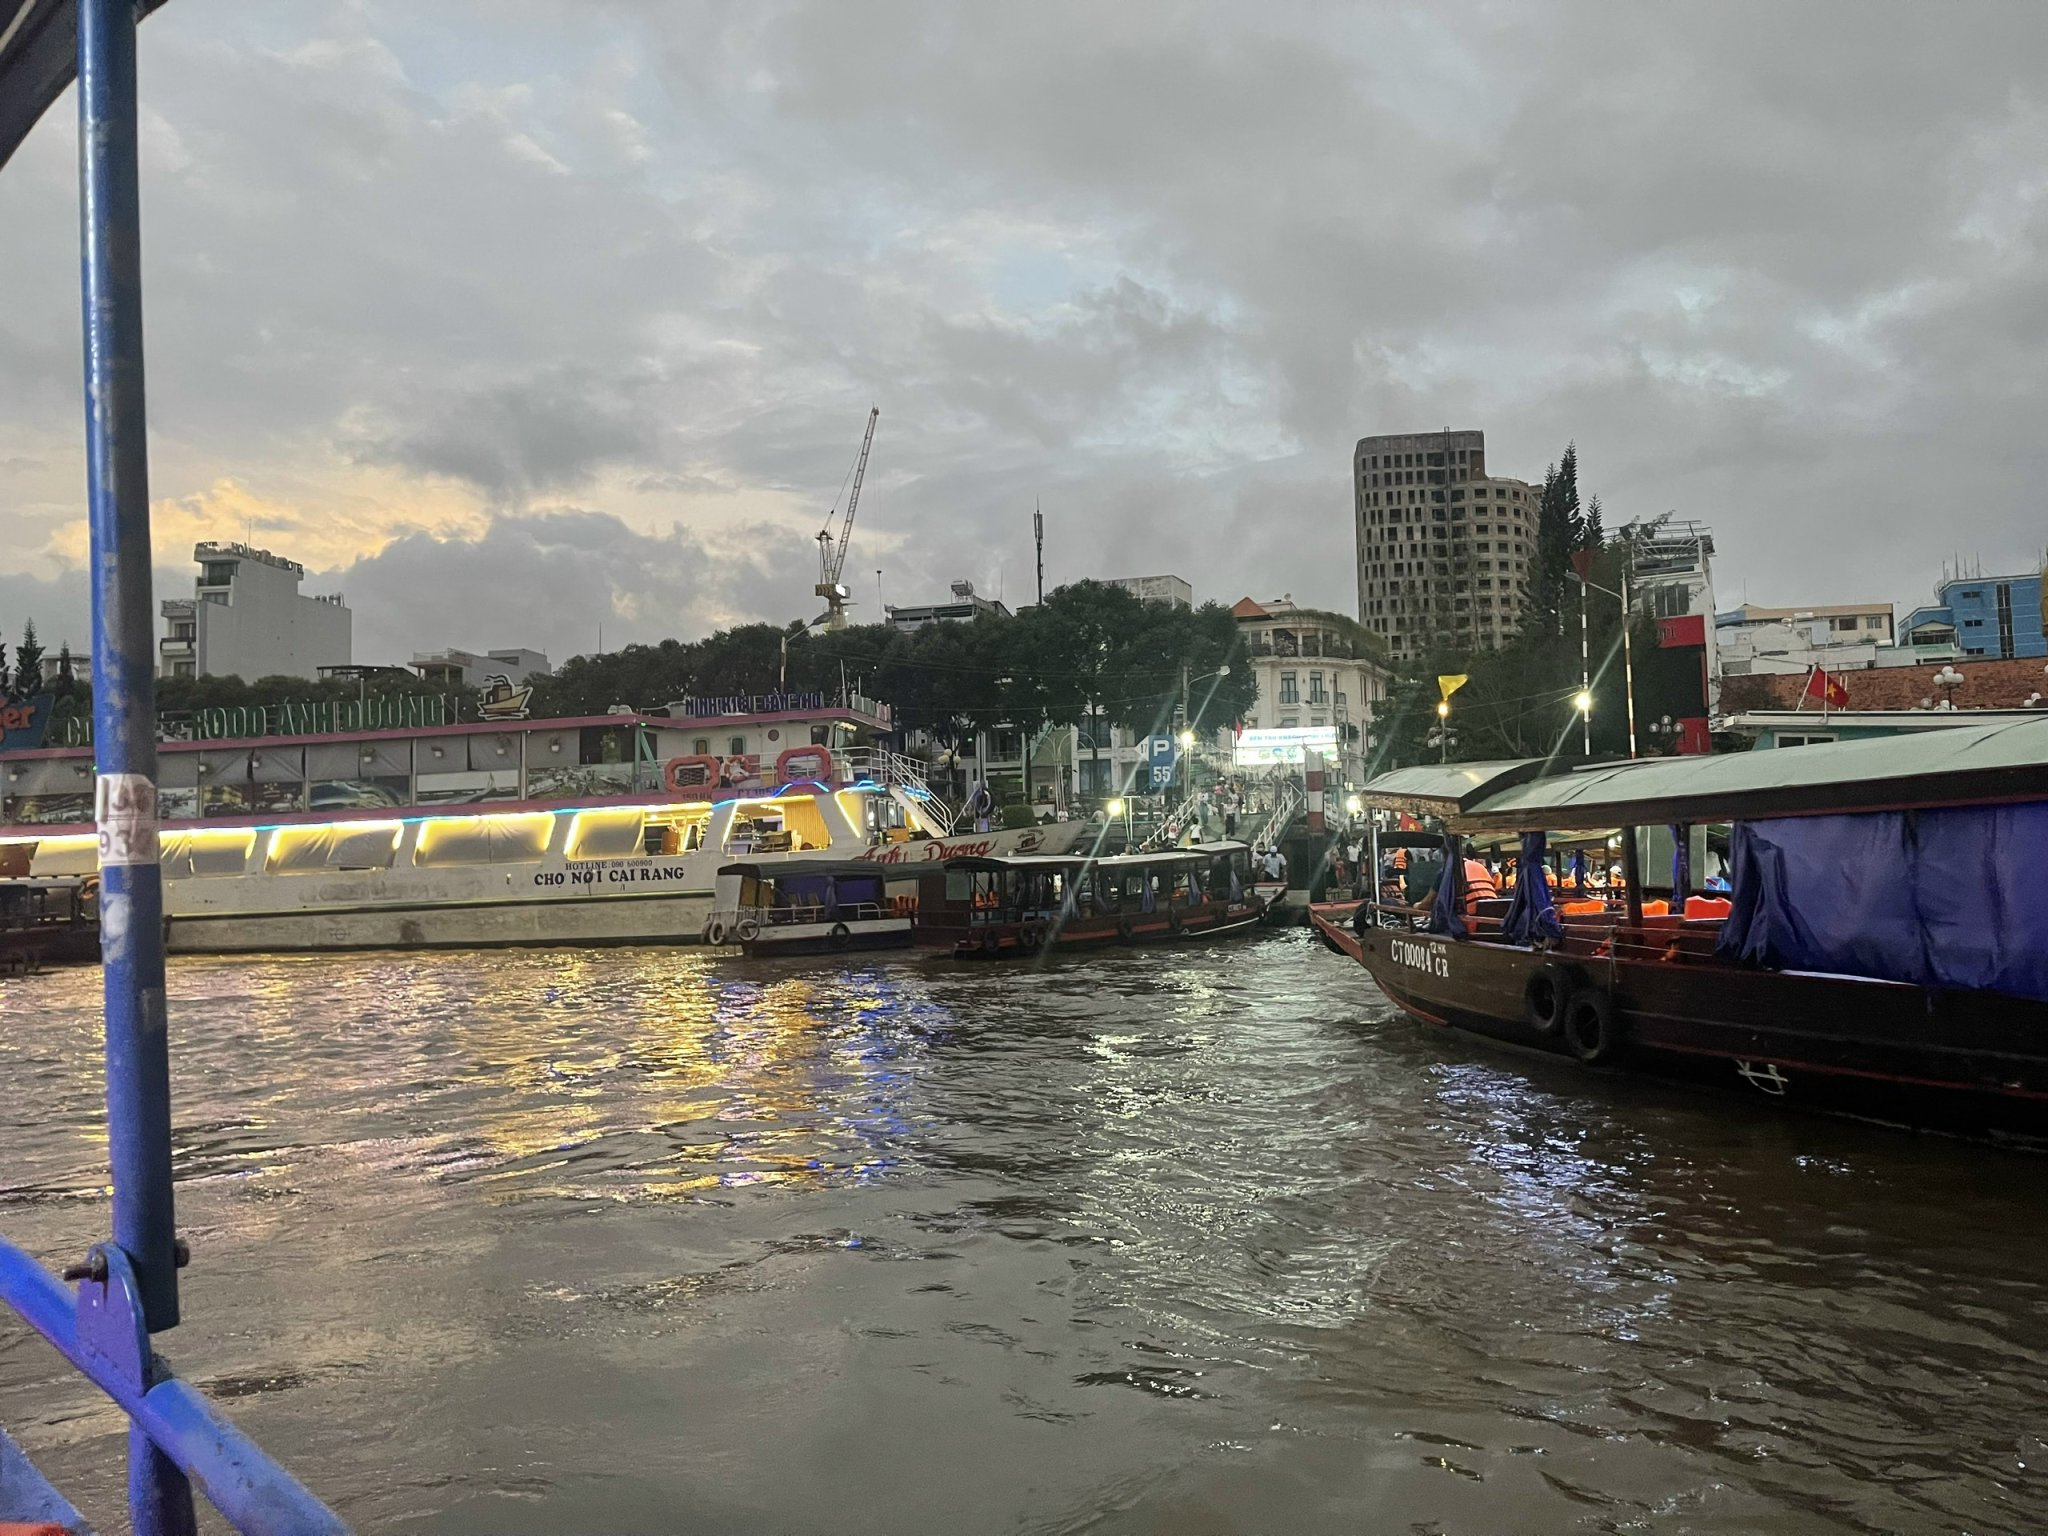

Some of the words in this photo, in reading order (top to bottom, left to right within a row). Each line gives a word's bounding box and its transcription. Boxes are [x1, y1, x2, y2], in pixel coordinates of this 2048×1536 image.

[1153, 740, 1170, 756] P
[1153, 766, 1171, 783] 55
[1435, 957, 1449, 978] CR
